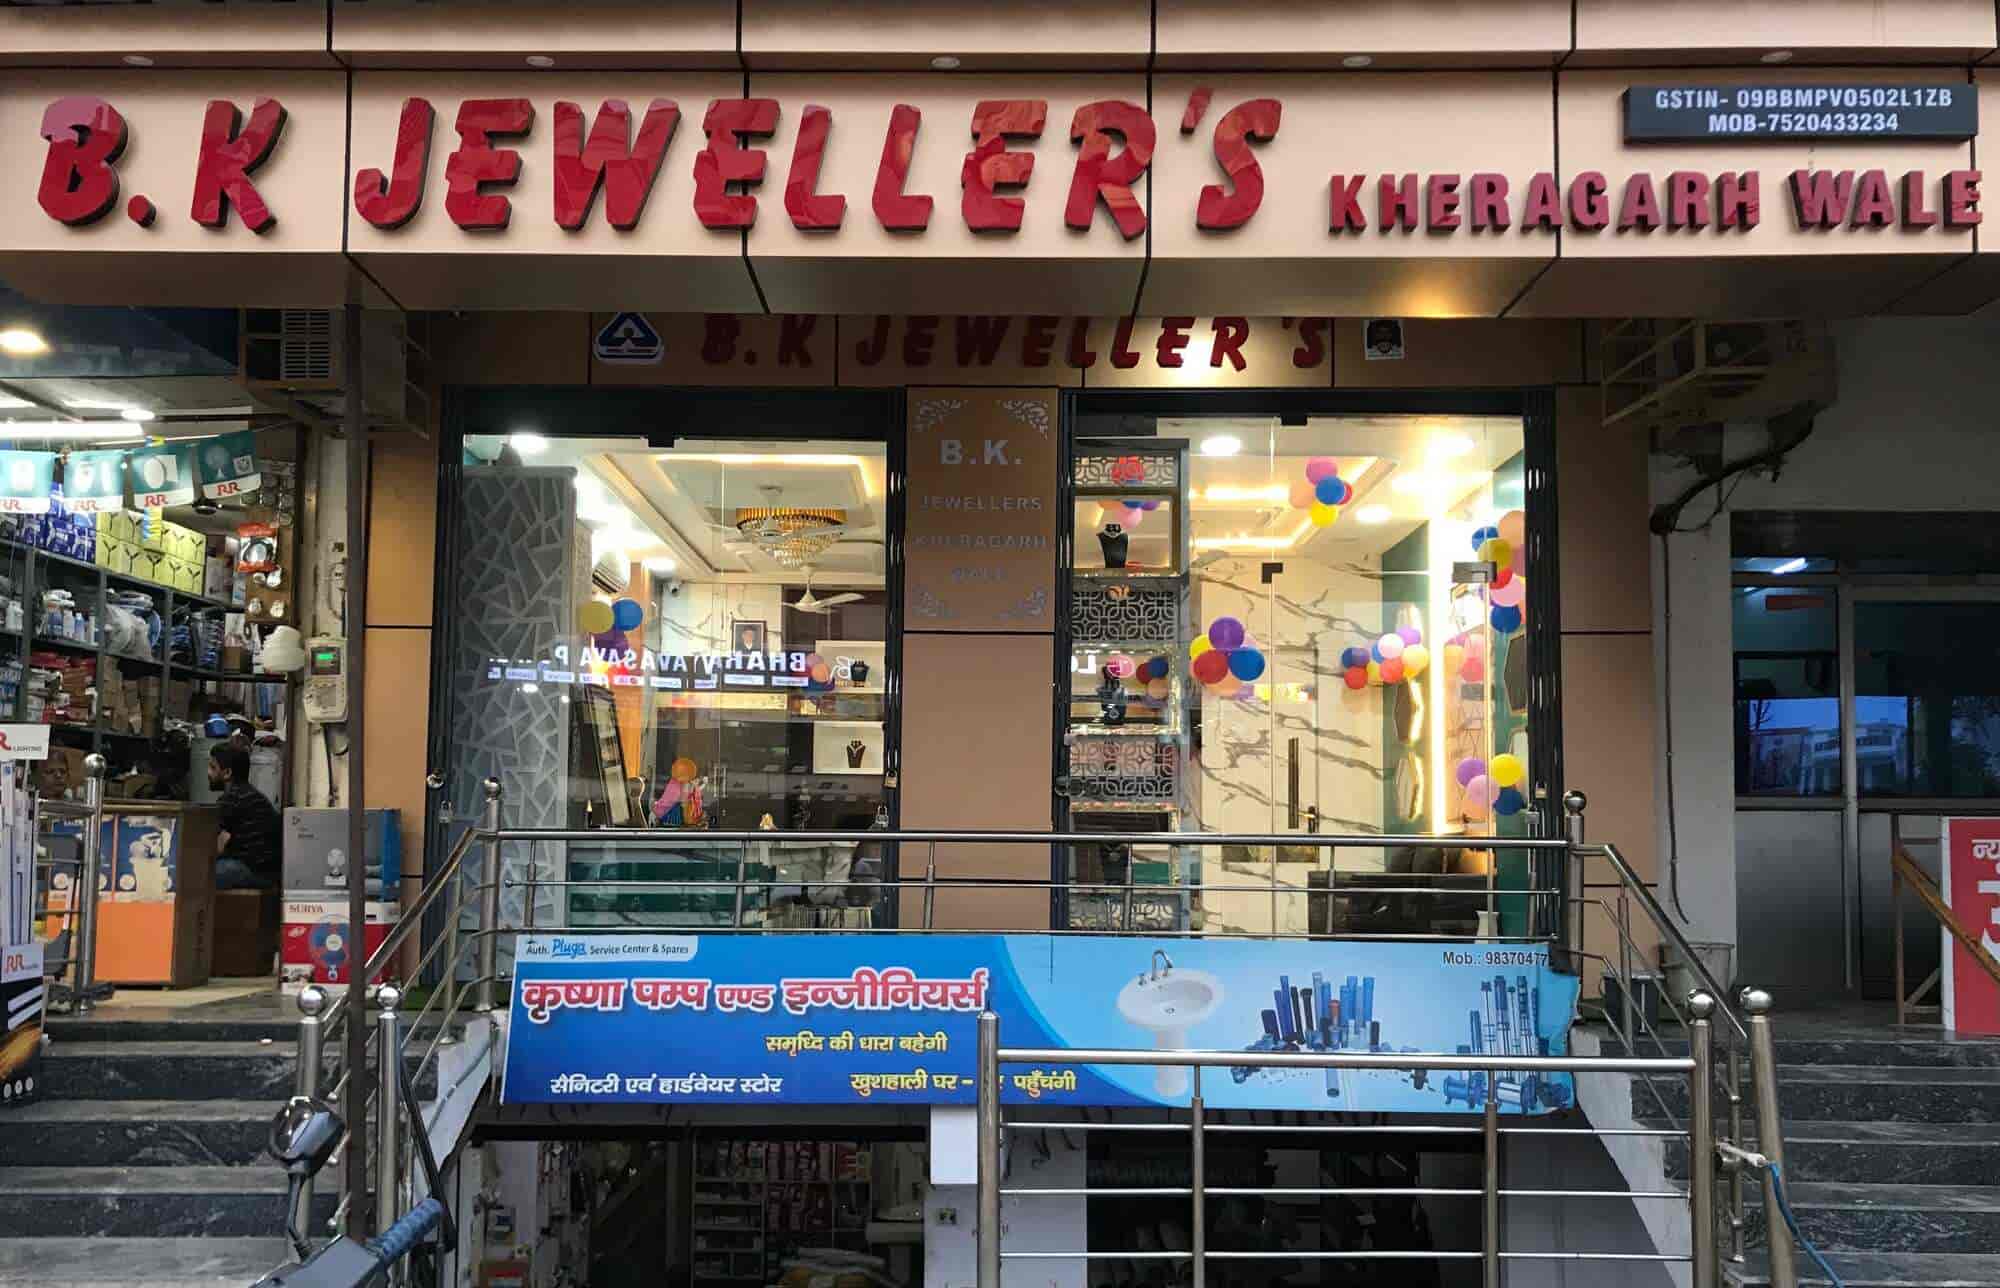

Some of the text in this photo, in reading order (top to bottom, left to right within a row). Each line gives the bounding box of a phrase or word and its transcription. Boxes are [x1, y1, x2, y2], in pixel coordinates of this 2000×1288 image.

[1708, 113, 1899, 132] MOB-7520433234
[355, 87, 1281, 240] JEWELLER'S
[1329, 170, 1983, 235] KHERAGARH WALE
[590, 944, 623, 955] Service
[622, 943, 650, 954] Center
[661, 944, 689, 956] Spares
[523, 980, 627, 1021] कृष्णा
[632, 980, 711, 1009] पम्प
[716, 986, 775, 1012] एण्ड
[829, 1031, 854, 1051] की
[860, 1036, 894, 1051] धारा
[899, 1031, 948, 1053] बहेगी
[550, 1073, 619, 1094] सैनिटरी
[625, 1073, 657, 1093] एवं
[740, 1073, 783, 1093] स्टोर
[850, 1068, 928, 1097] खुशहाली
